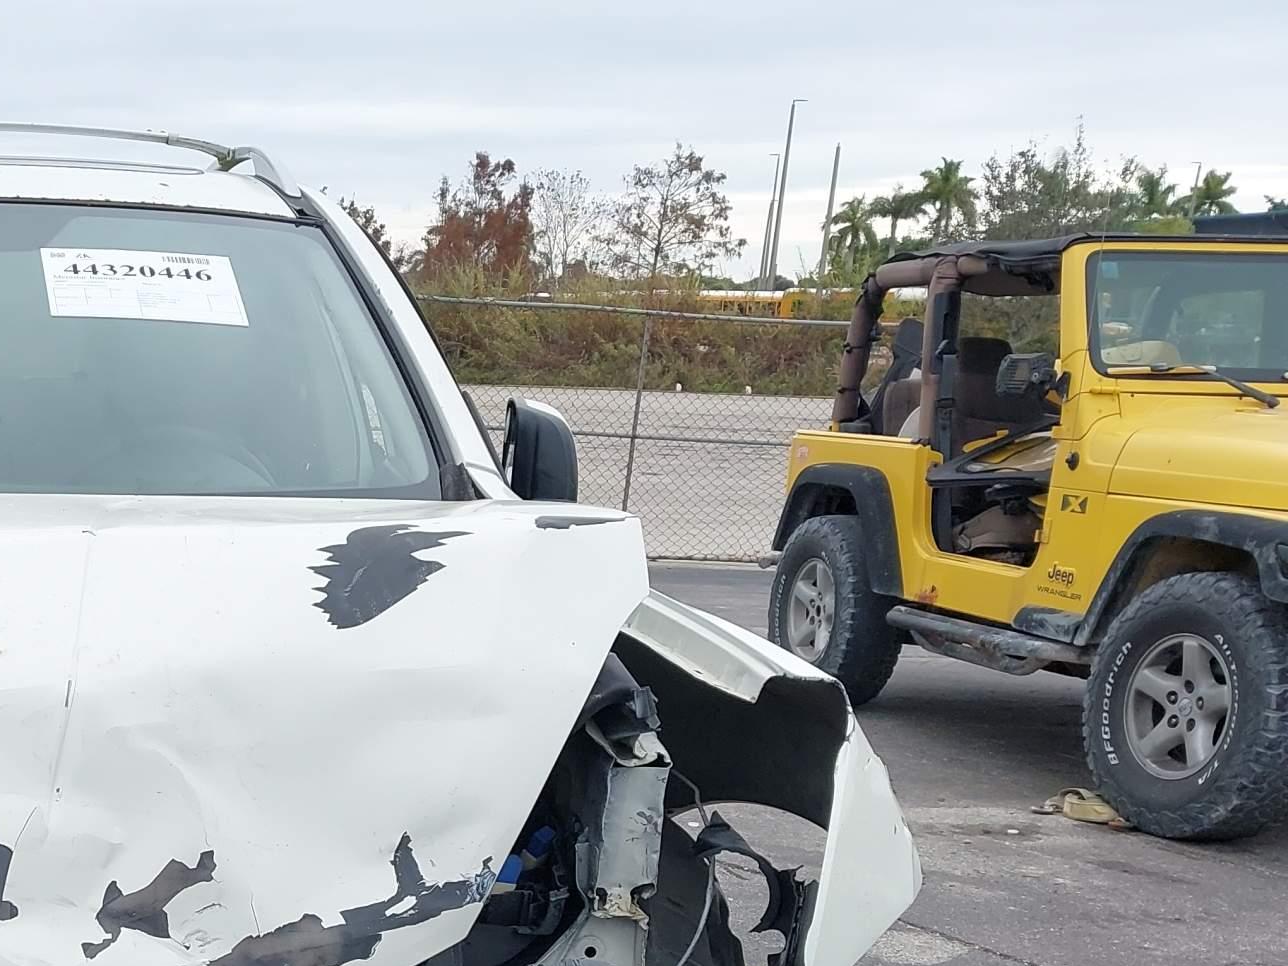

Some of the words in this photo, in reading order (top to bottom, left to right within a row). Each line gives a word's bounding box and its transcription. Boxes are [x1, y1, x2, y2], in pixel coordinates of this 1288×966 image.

[63, 263, 212, 281] 44320446
[1047, 564, 1075, 587] Jeep
[1037, 585, 1082, 601] WRANGLER
[774, 574, 786, 646] Goodrich
[1101, 641, 1132, 765] BFGoodrich
